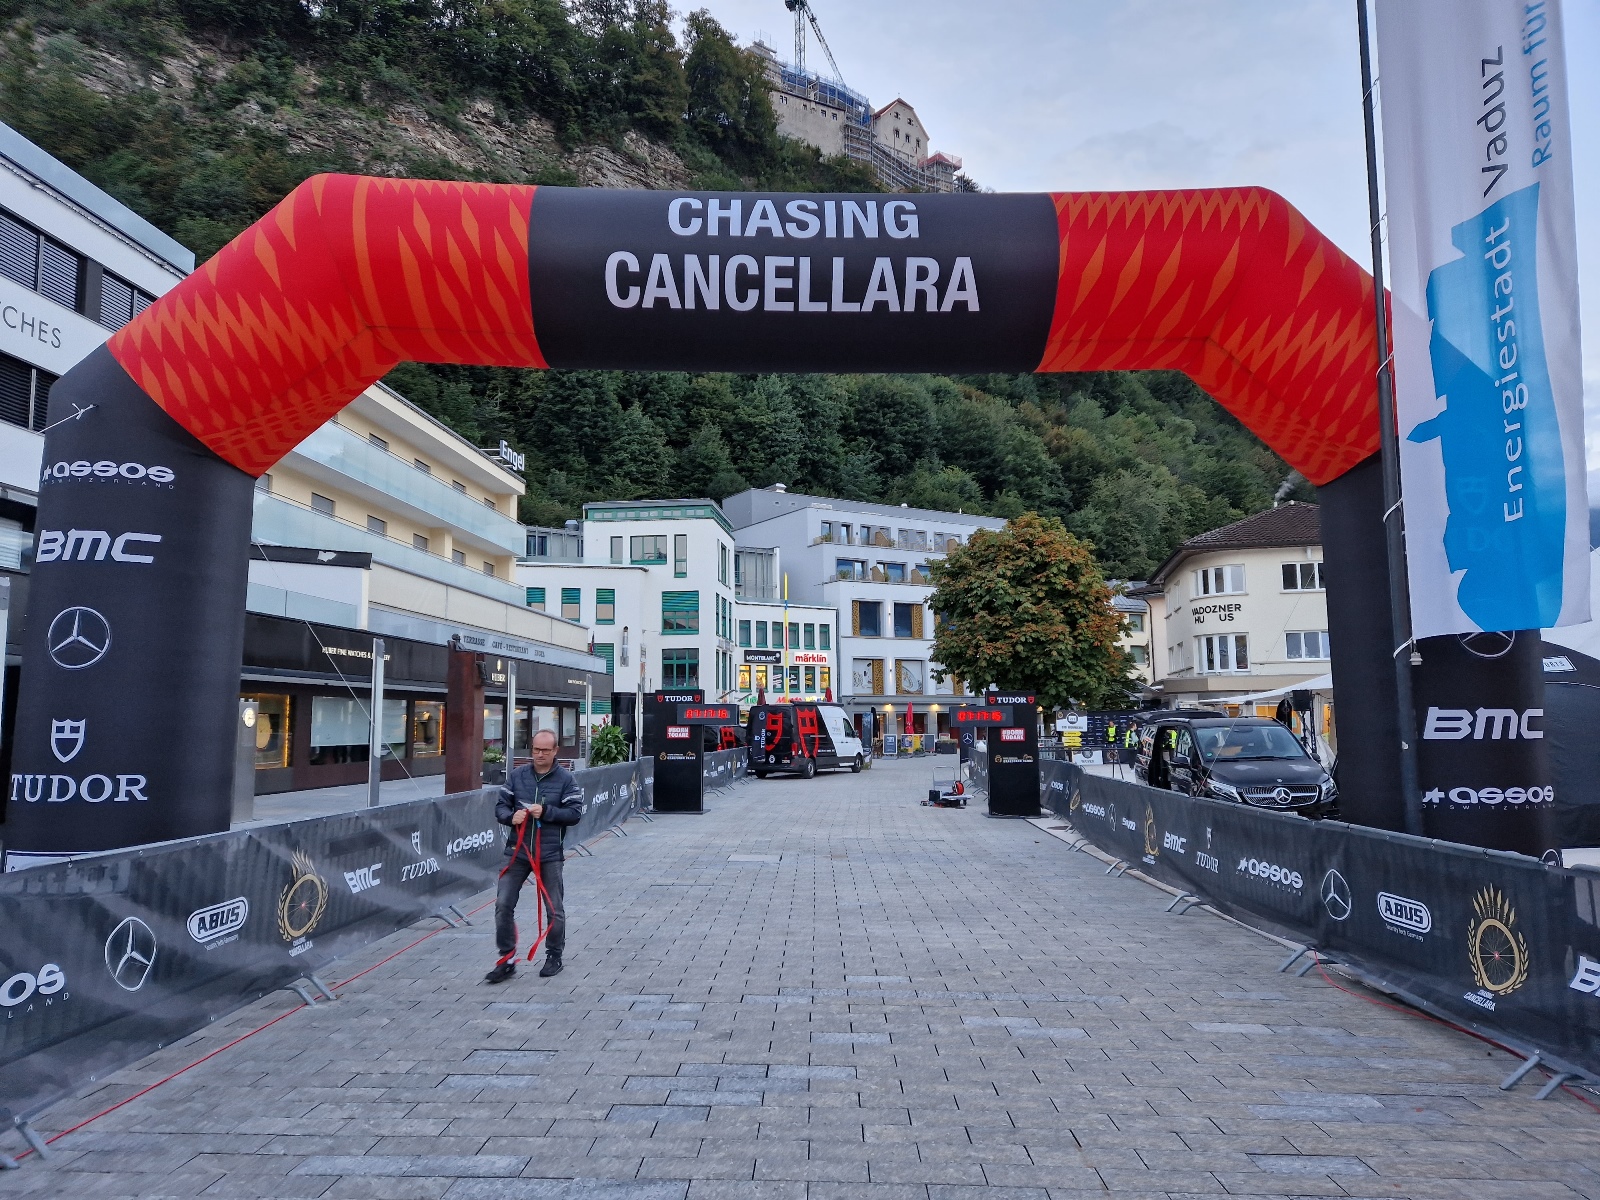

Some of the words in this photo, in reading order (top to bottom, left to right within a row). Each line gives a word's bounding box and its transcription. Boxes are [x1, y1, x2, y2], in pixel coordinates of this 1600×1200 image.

[1522, 2, 1547, 55] für
[1476, 45, 1509, 198] Vaduz
[1531, 58, 1553, 169] Raum
[667, 197, 920, 239] CHASING
[604, 250, 981, 312] CANCELLARA
[0, 300, 62, 349] CHES
[1484, 216, 1529, 522] Energiestadt
[500, 440, 525, 471] Engel
[52, 460, 175, 482] assos
[36, 528, 162, 565] BMC
[1191, 603, 1242, 616] VADOZNER
[1194, 615, 1205, 624] HU
[1219, 613, 1235, 622] US
[746, 654, 776, 662] MONTBLANC
[795, 653, 827, 663] märklin
[996, 696, 1027, 704] TUDOR
[1423, 706, 1544, 740] BMC
[10, 773, 148, 803] TUDOR
[1448, 785, 1554, 804] assos
[1163, 830, 1187, 854] BMC
[400, 857, 441, 882] TUDOR
[1195, 851, 1219, 874] TUDOR
[1248, 858, 1304, 889] assos
[343, 862, 382, 894] BMC
[196, 905, 242, 935] ABUS
[1384, 899, 1424, 925] ABUS
[1463, 991, 1496, 1012] CANCELLARA
